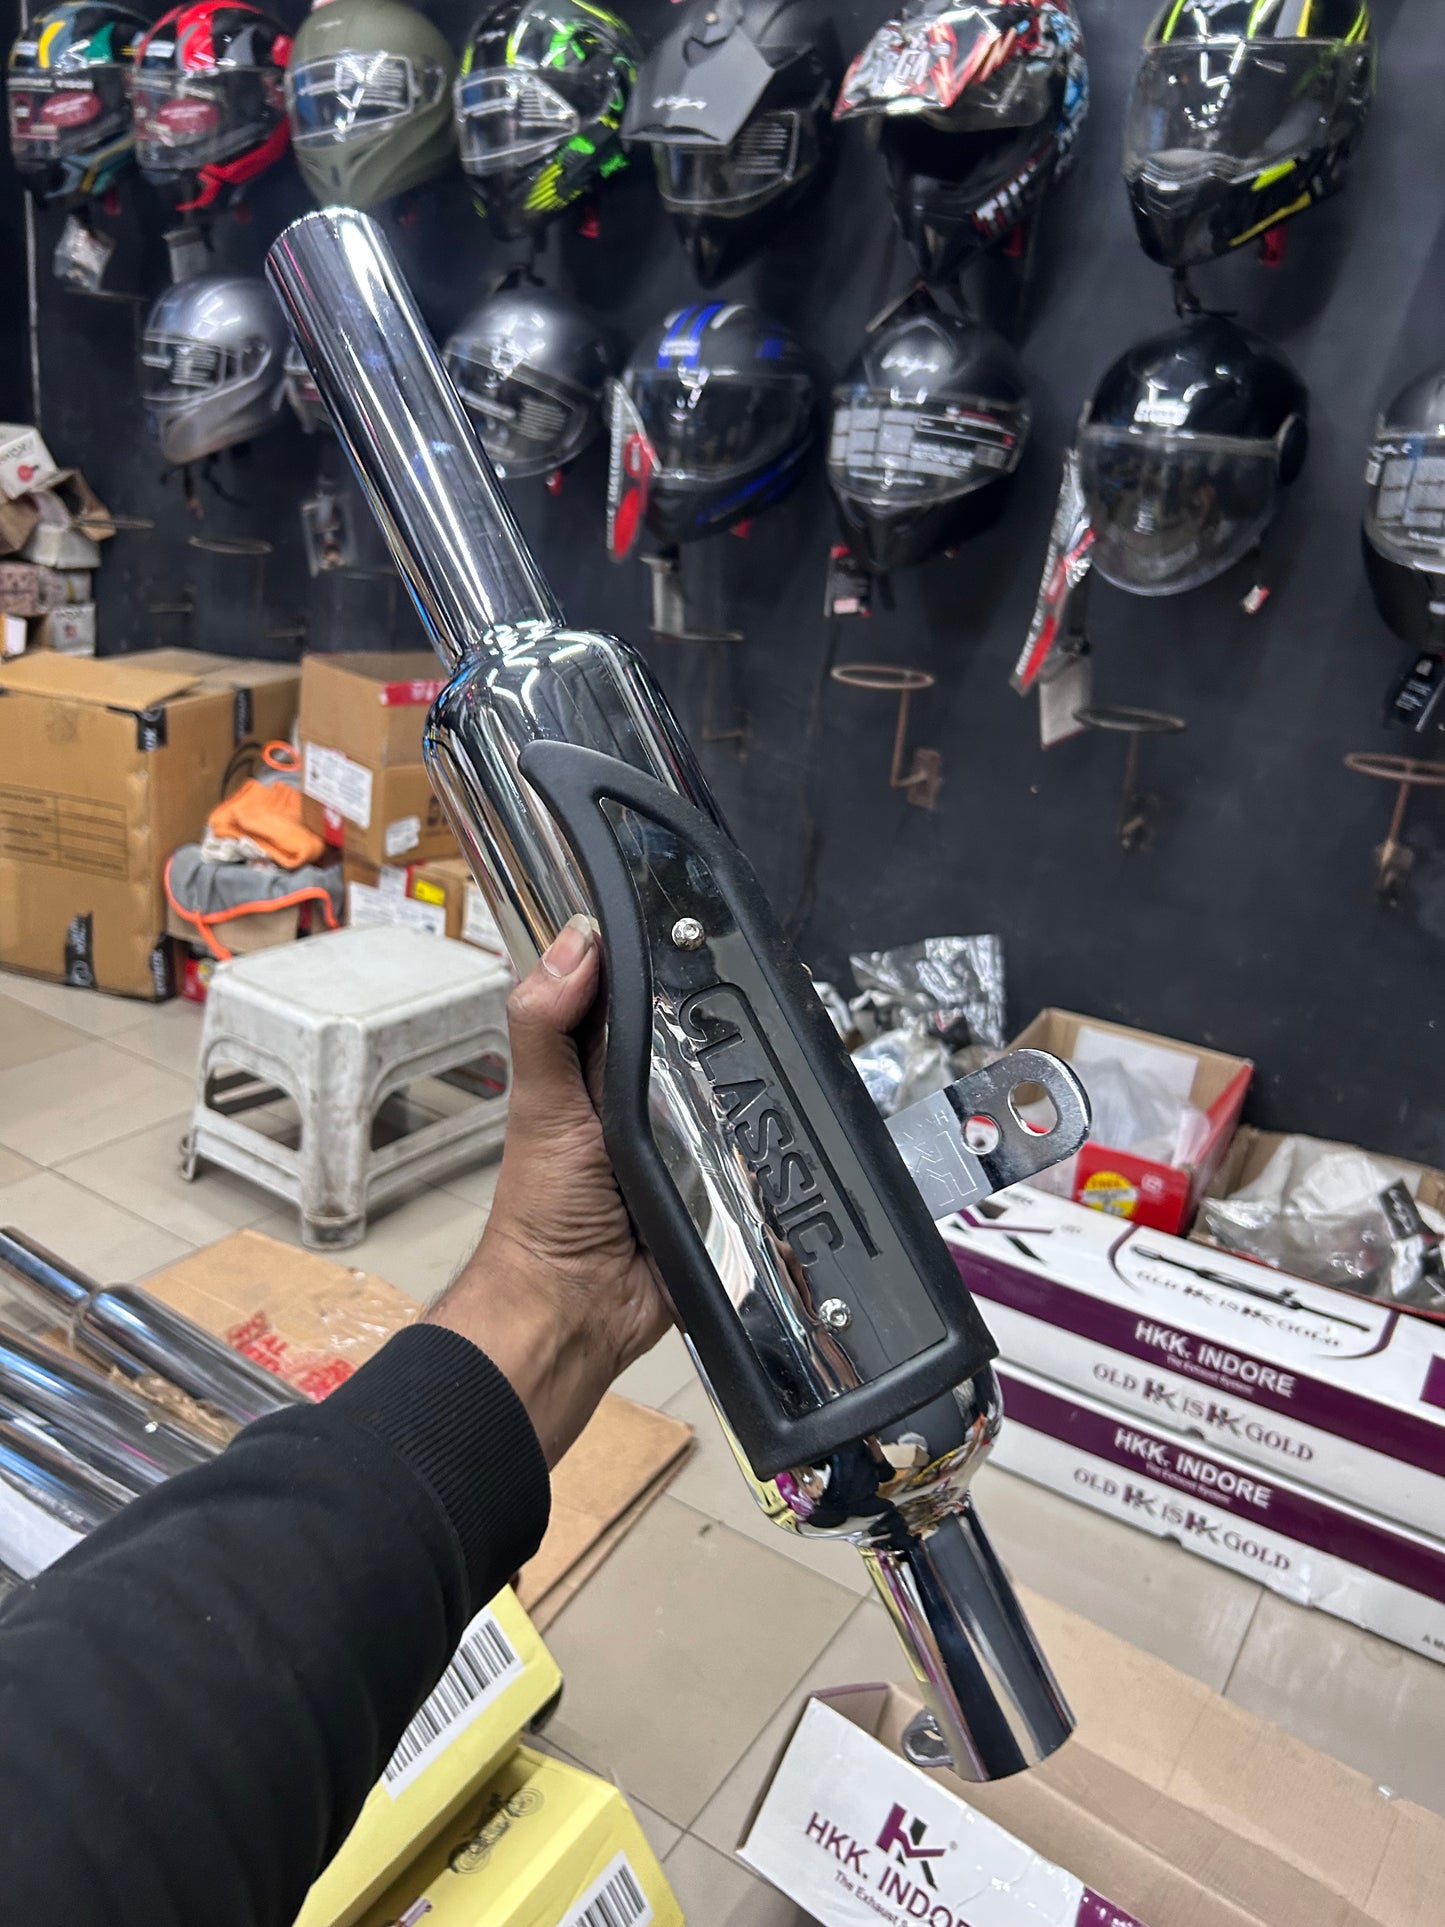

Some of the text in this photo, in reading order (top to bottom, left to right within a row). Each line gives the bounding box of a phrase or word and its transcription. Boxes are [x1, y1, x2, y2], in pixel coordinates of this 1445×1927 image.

[678, 981, 846, 1268] CLASSIC
[1197, 1343, 1297, 1399] INDORE
[1093, 1362, 1137, 1391] OLD
[1182, 1397, 1205, 1419] IS
[1245, 1421, 1314, 1462] GOLD
[1175, 1452, 1273, 1510] INDORE
[1073, 1467, 1117, 1496] OLD
[1161, 1502, 1184, 1526] IS
[1223, 1530, 1291, 1572] GOLD
[804, 1810, 870, 1880] HKK.
[835, 1868, 899, 1926] The Exhaust
